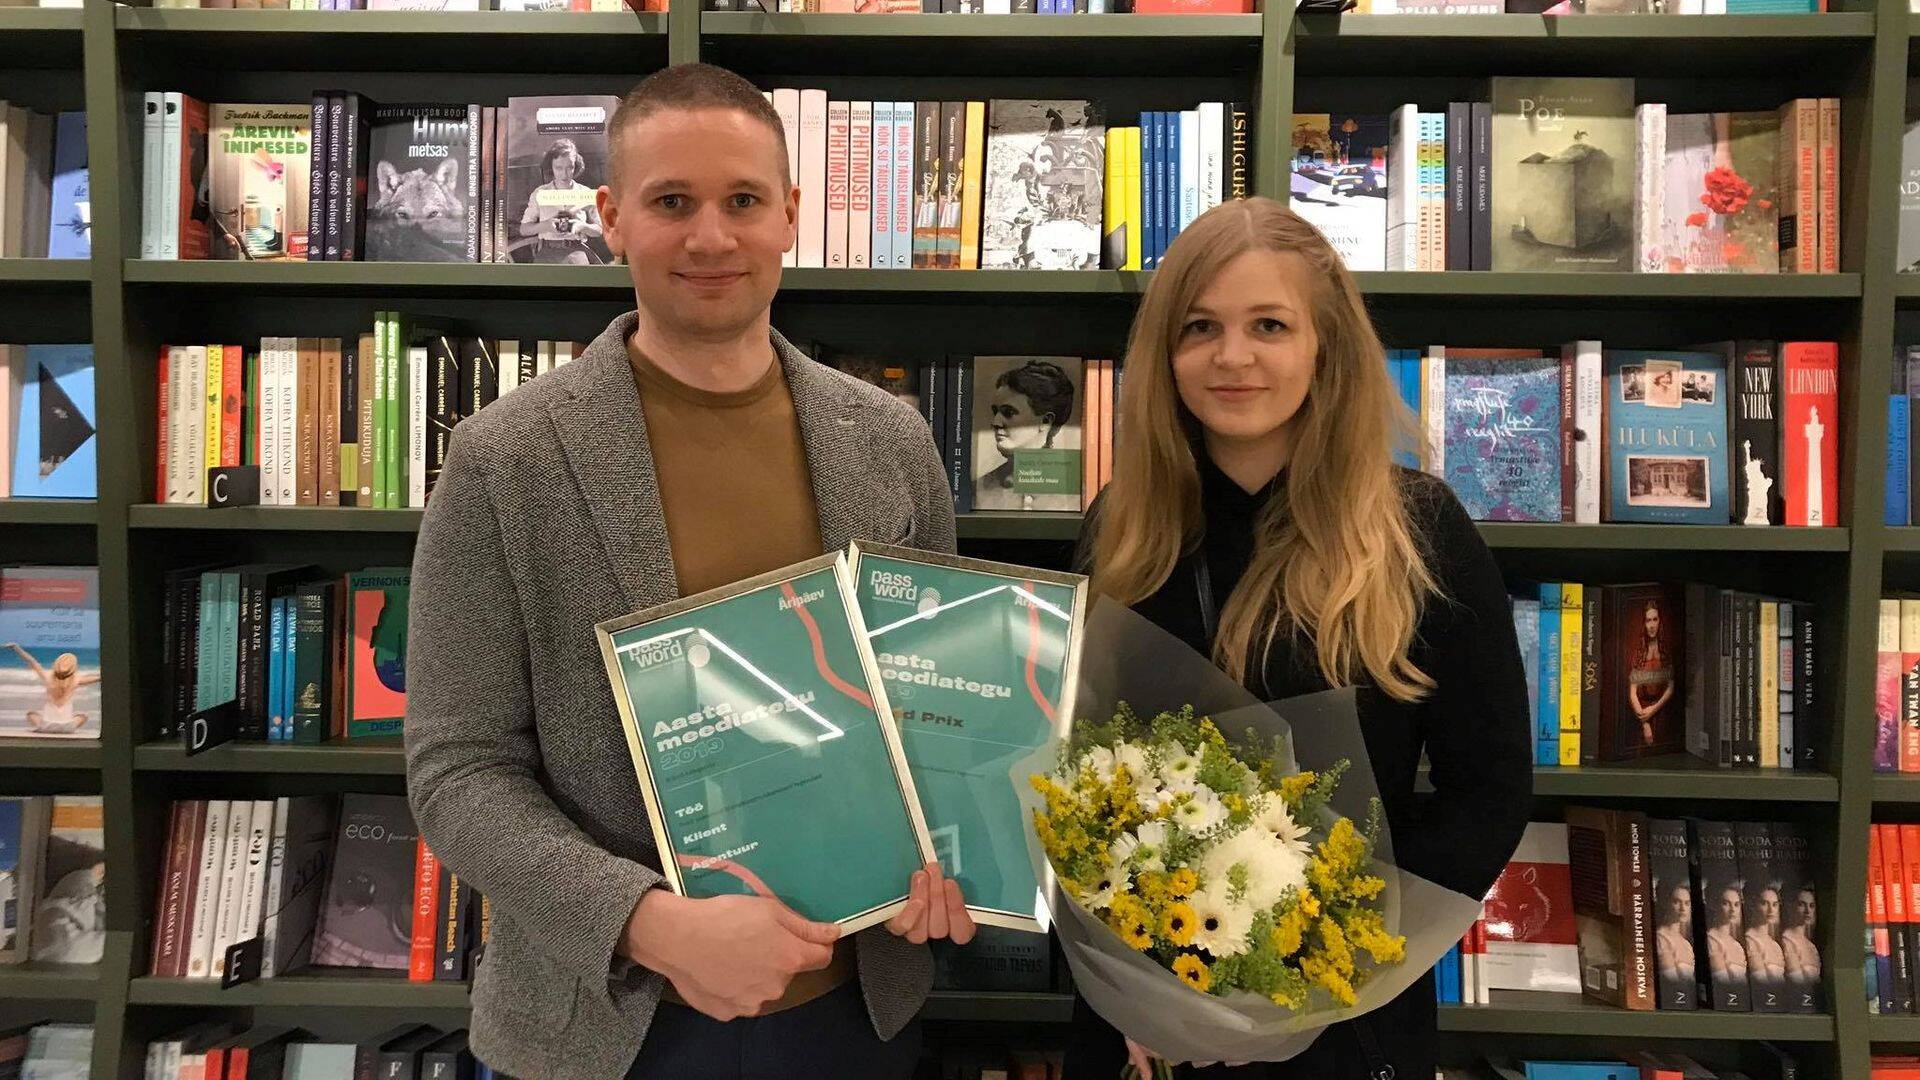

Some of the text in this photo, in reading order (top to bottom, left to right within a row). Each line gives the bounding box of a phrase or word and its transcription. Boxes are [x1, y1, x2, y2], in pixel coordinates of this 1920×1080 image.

[224, 110, 309, 120] Fredrik Backman
[376, 109, 404, 118] MARTIN
[407, 108, 440, 117] ALLISON
[1517, 98, 1565, 121] POE
[224, 141, 307, 154] INIMESED
[313, 104, 325, 161] Bonaventura
[330, 104, 341, 162] Bonaventura
[408, 143, 448, 157] metsas
[468, 112, 479, 198] SINISTRA RINGKOND
[876, 149, 888, 161] SU
[1232, 112, 1247, 201] ISHIGUR
[829, 125, 847, 211] PIHTIMUSED
[851, 125, 869, 211] PIHTIMUSED
[467, 205, 477, 233] BODOR
[190, 353, 198, 369] RAY
[374, 320, 386, 399] Jeremy Clarkson
[387, 320, 399, 400] Jeremy Clarkson
[437, 357, 445, 388] EMMANUEL
[473, 357, 481, 388] EMMANUEL
[520, 353, 532, 384] ALKE
[1744, 367, 1773, 393] NEW
[1790, 368, 1837, 395] LONDON
[1742, 393, 1774, 420] YORK
[209, 413, 217, 467] MINIATURI
[263, 387, 274, 475] KOERA TEEKOND
[282, 387, 292, 475] KOERA TEEKOND
[361, 399, 373, 464] PITSIKUDUJA
[414, 425, 422, 462] LIMONOV
[213, 474, 228, 502] C
[352, 577, 402, 588] VERNON
[870, 570, 913, 588] pass
[874, 583, 918, 601] word
[252, 589, 263, 651] ROALD DAHL
[271, 606, 281, 654] SYLVIA DAY
[286, 606, 297, 654] SYLVIA DAY
[1805, 621, 1814, 644] ANNE
[635, 641, 682, 669] word
[878, 652, 936, 671] asta
[880, 669, 1013, 699] eediategu
[1805, 681, 1814, 705] VERA
[652, 702, 732, 738] Aasta
[921, 710, 964, 728] Prix
[1908, 664, 1920, 756] TAN TWAN ENG
[192, 719, 208, 749] D
[369, 720, 402, 733] DESP
[674, 802, 704, 818] Töö
[249, 828, 264, 865] Clea
[345, 823, 385, 840] eco
[682, 823, 728, 845] Klient
[690, 841, 760, 872] Agentuur
[1631, 823, 1641, 873] AMOR TOWLES
[169, 871, 182, 900] KOLM
[418, 886, 432, 915] ECO
[445, 873, 458, 952] anhattan Beach
[1633, 894, 1648, 998] HÄRRASMEES MOSKVAS
[230, 948, 242, 981] E
